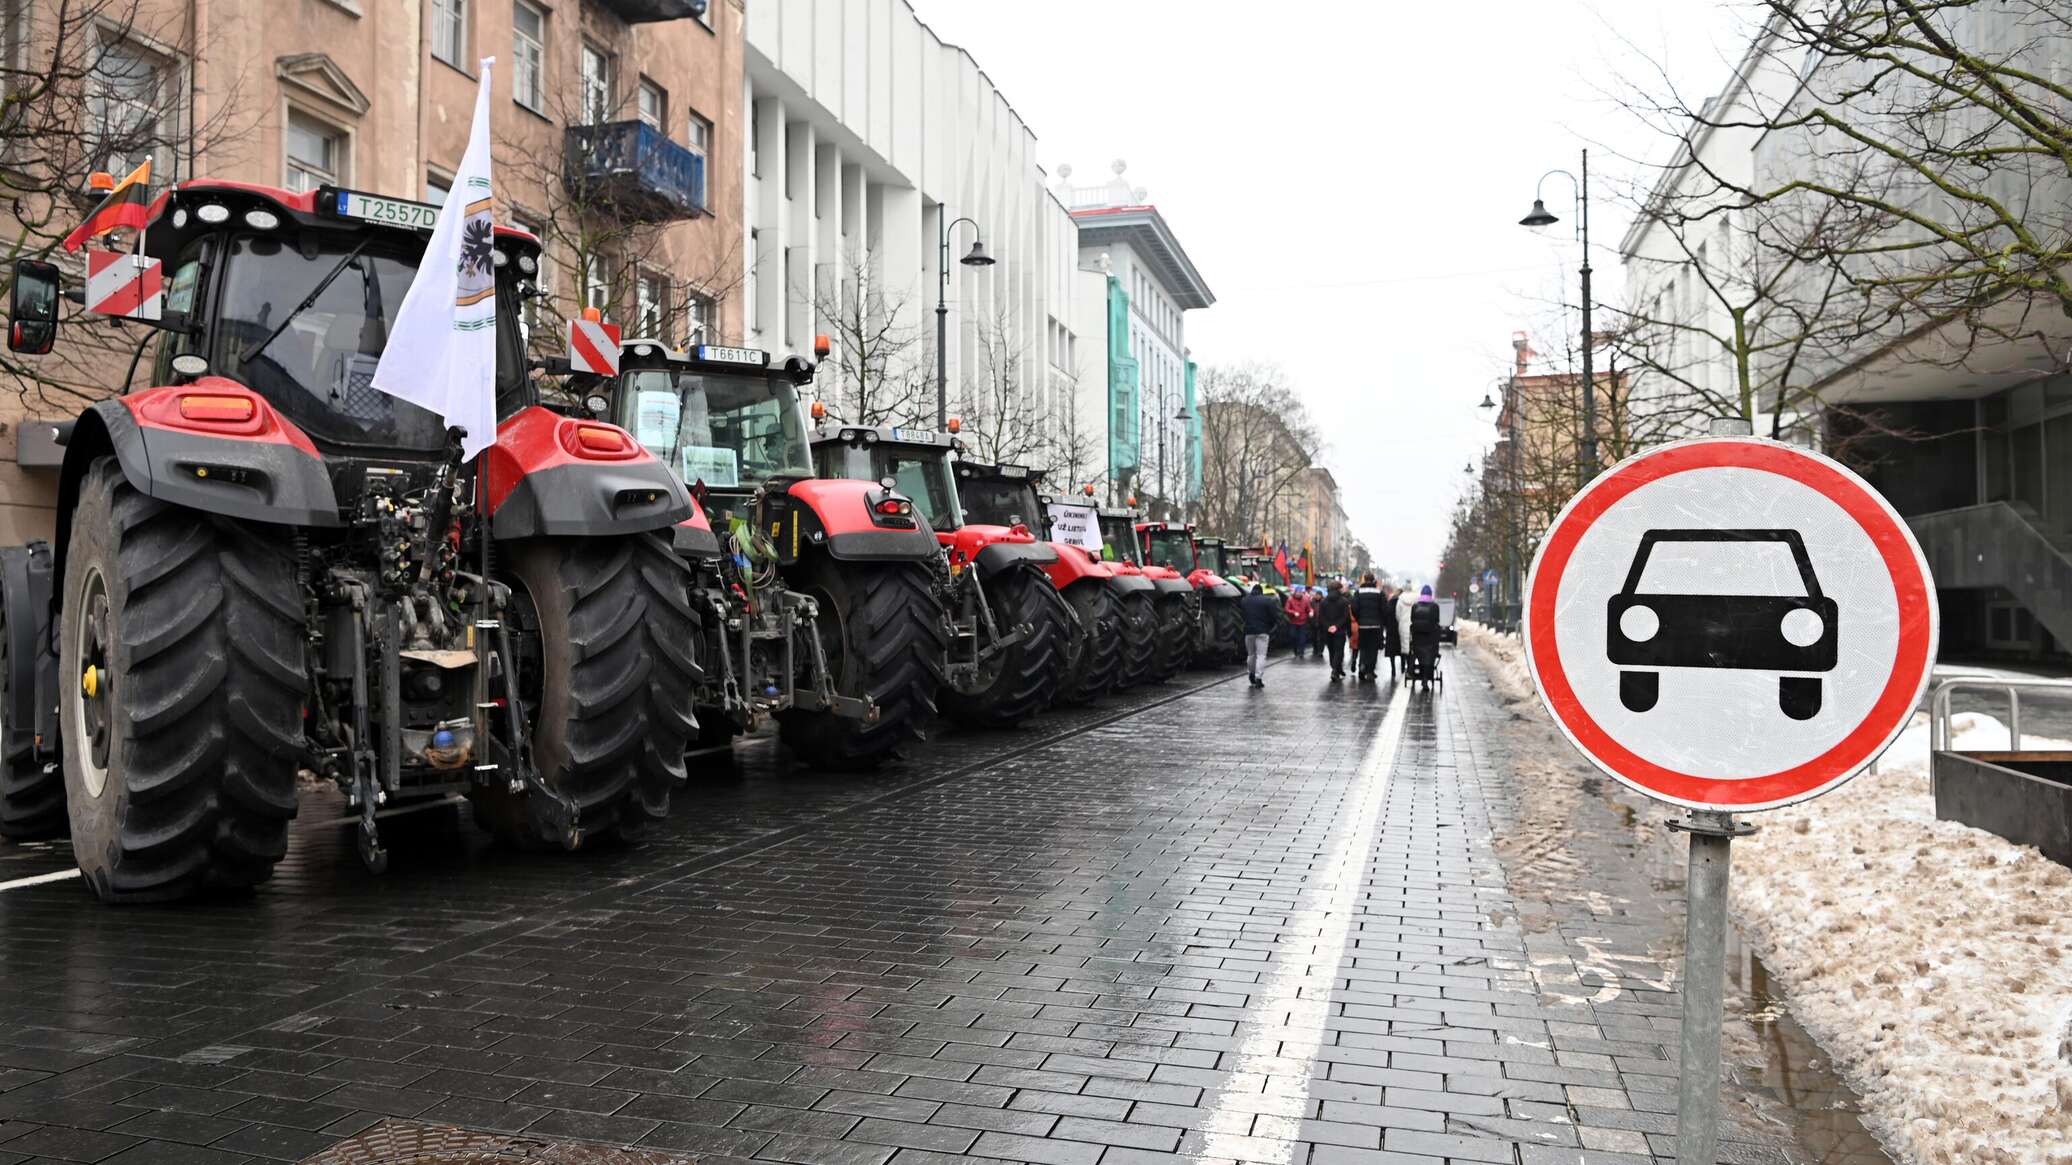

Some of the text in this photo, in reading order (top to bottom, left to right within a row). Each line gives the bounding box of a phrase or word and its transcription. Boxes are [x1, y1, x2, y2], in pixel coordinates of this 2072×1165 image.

[358, 197, 436, 227] T2557D
[711, 347, 757, 363] T6611C
[1057, 522, 1067, 531] UŽ
